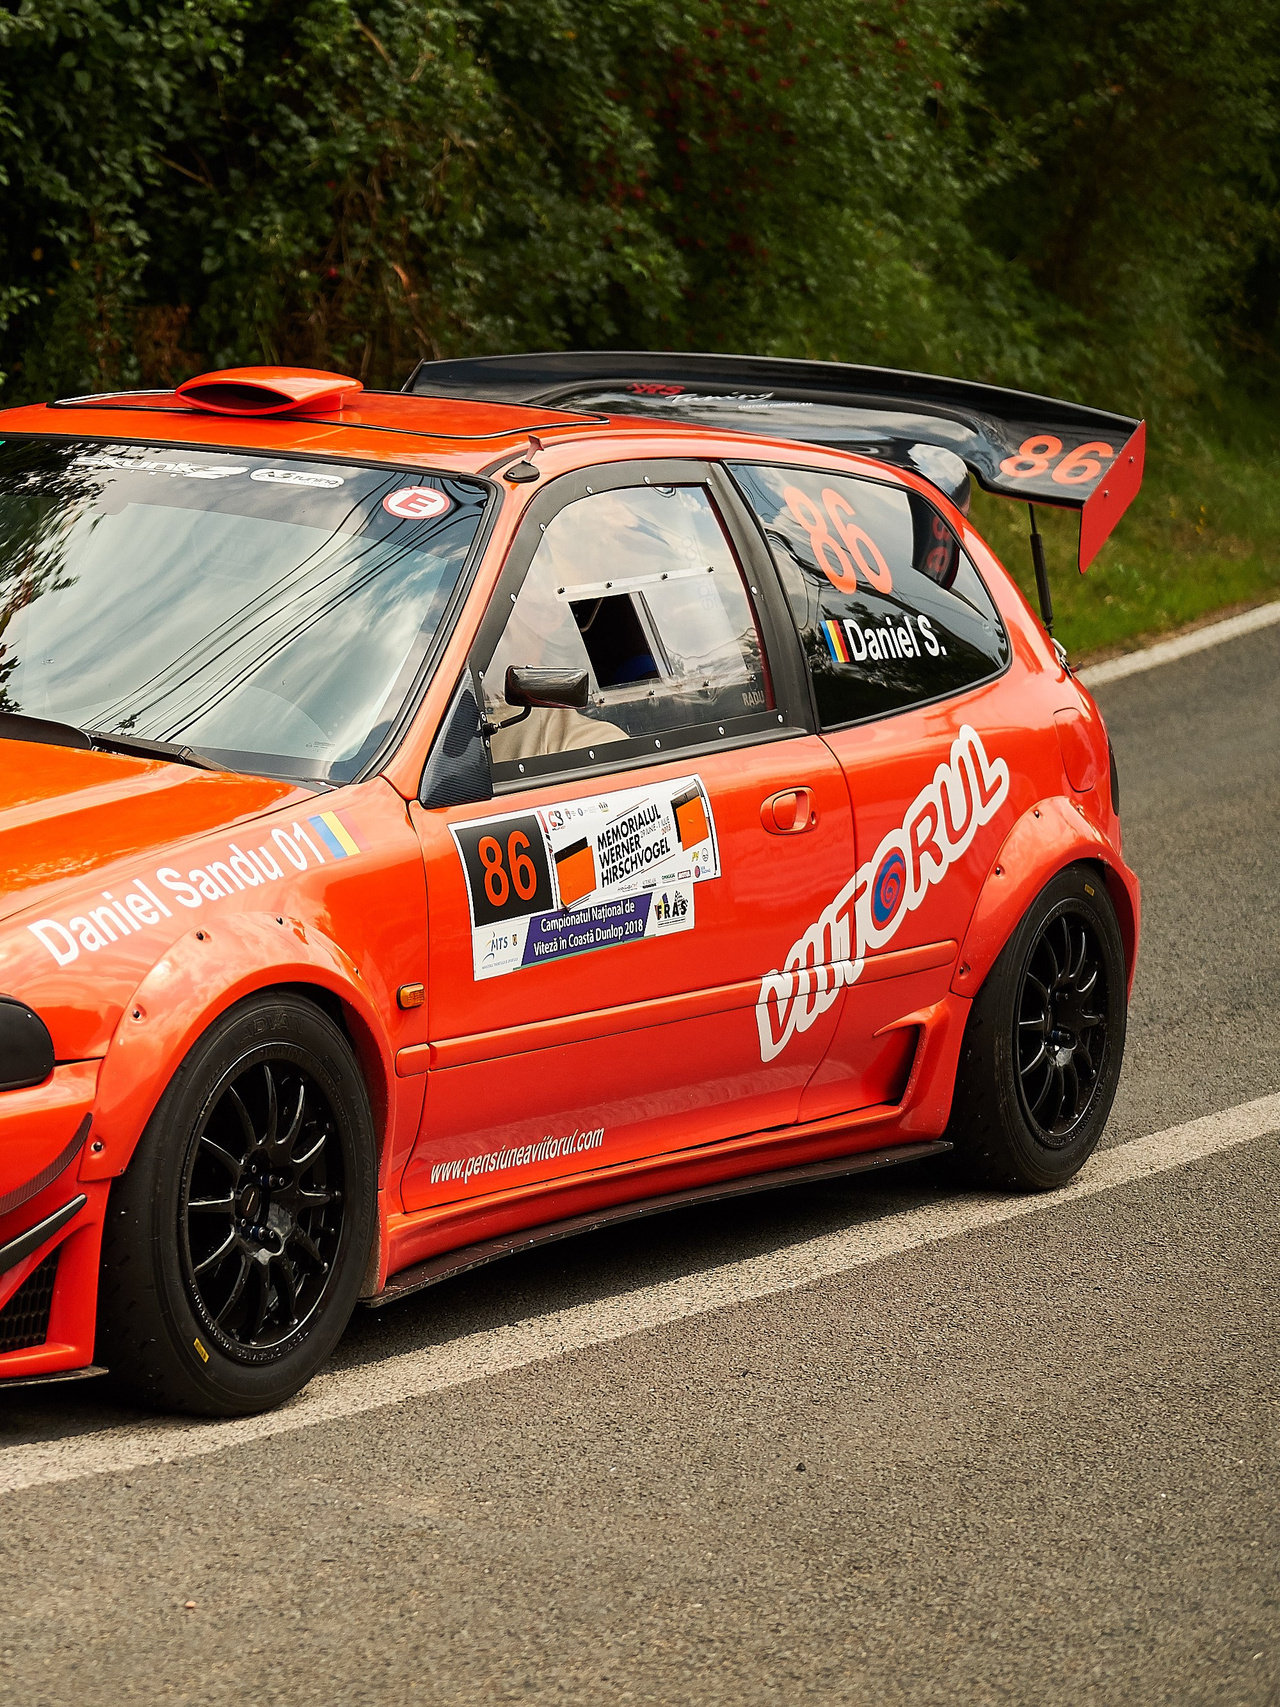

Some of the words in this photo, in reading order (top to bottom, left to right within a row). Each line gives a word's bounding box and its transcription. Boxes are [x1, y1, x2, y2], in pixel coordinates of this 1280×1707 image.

[1000, 435, 1114, 485] 86
[395, 492, 438, 514] E
[783, 486, 893, 595] 86
[842, 616, 921, 662] Daniel
[917, 614, 948, 657] S.
[597, 804, 661, 851] MEMORIALUL
[598, 833, 641, 869] WERNER
[478, 829, 538, 907] 86
[601, 837, 671, 888] HIRSCHVOGEL
[27, 878, 173, 967] Daniel
[156, 844, 285, 908] Sandu
[271, 822, 326, 872] 01
[540, 909, 591, 933] Campionatul
[624, 900, 636, 915] de
[656, 900, 688, 920] FRAS
[533, 936, 559, 956] Viteză
[558, 934, 568, 950] în
[568, 927, 595, 948] Coastă
[595, 922, 624, 943] Dunlop
[624, 918, 644, 936] 2018
[430, 1127, 605, 1185] www.pensiuneaviitorul.com
